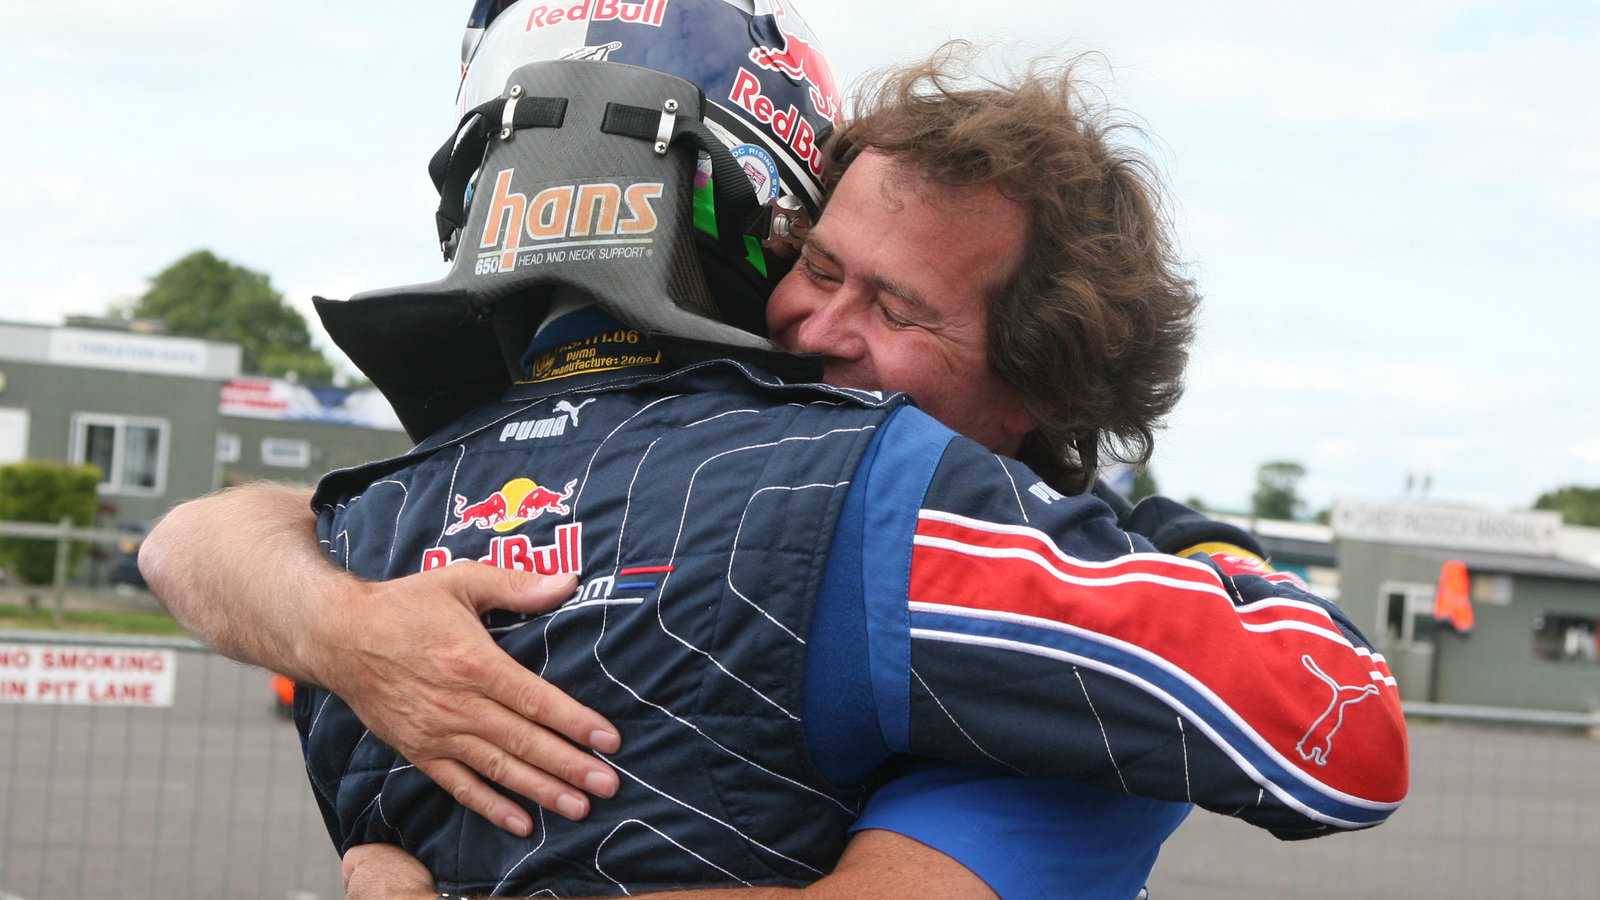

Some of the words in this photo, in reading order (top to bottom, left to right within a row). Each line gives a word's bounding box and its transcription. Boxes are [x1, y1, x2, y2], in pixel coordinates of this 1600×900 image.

[525, 0, 591, 32] Red
[593, 0, 667, 26] Bull
[729, 67, 799, 144] Red
[790, 116, 824, 176] Bu
[748, 147, 776, 174] RISING
[770, 178, 779, 198] STA
[480, 168, 664, 272] hans
[475, 257, 498, 275] 650
[518, 252, 543, 266] HEAD
[546, 250, 566, 264] AND
[568, 249, 595, 262] NECK
[599, 246, 645, 260] SUPPORT
[500, 415, 568, 441] PUMA
[502, 522, 582, 575] Bull
[0, 652, 30, 668] NO
[42, 652, 164, 672] SMOKING
[1, 681, 26, 697] IN
[38, 681, 77, 697] PIT
[88, 682, 154, 701] LANE
